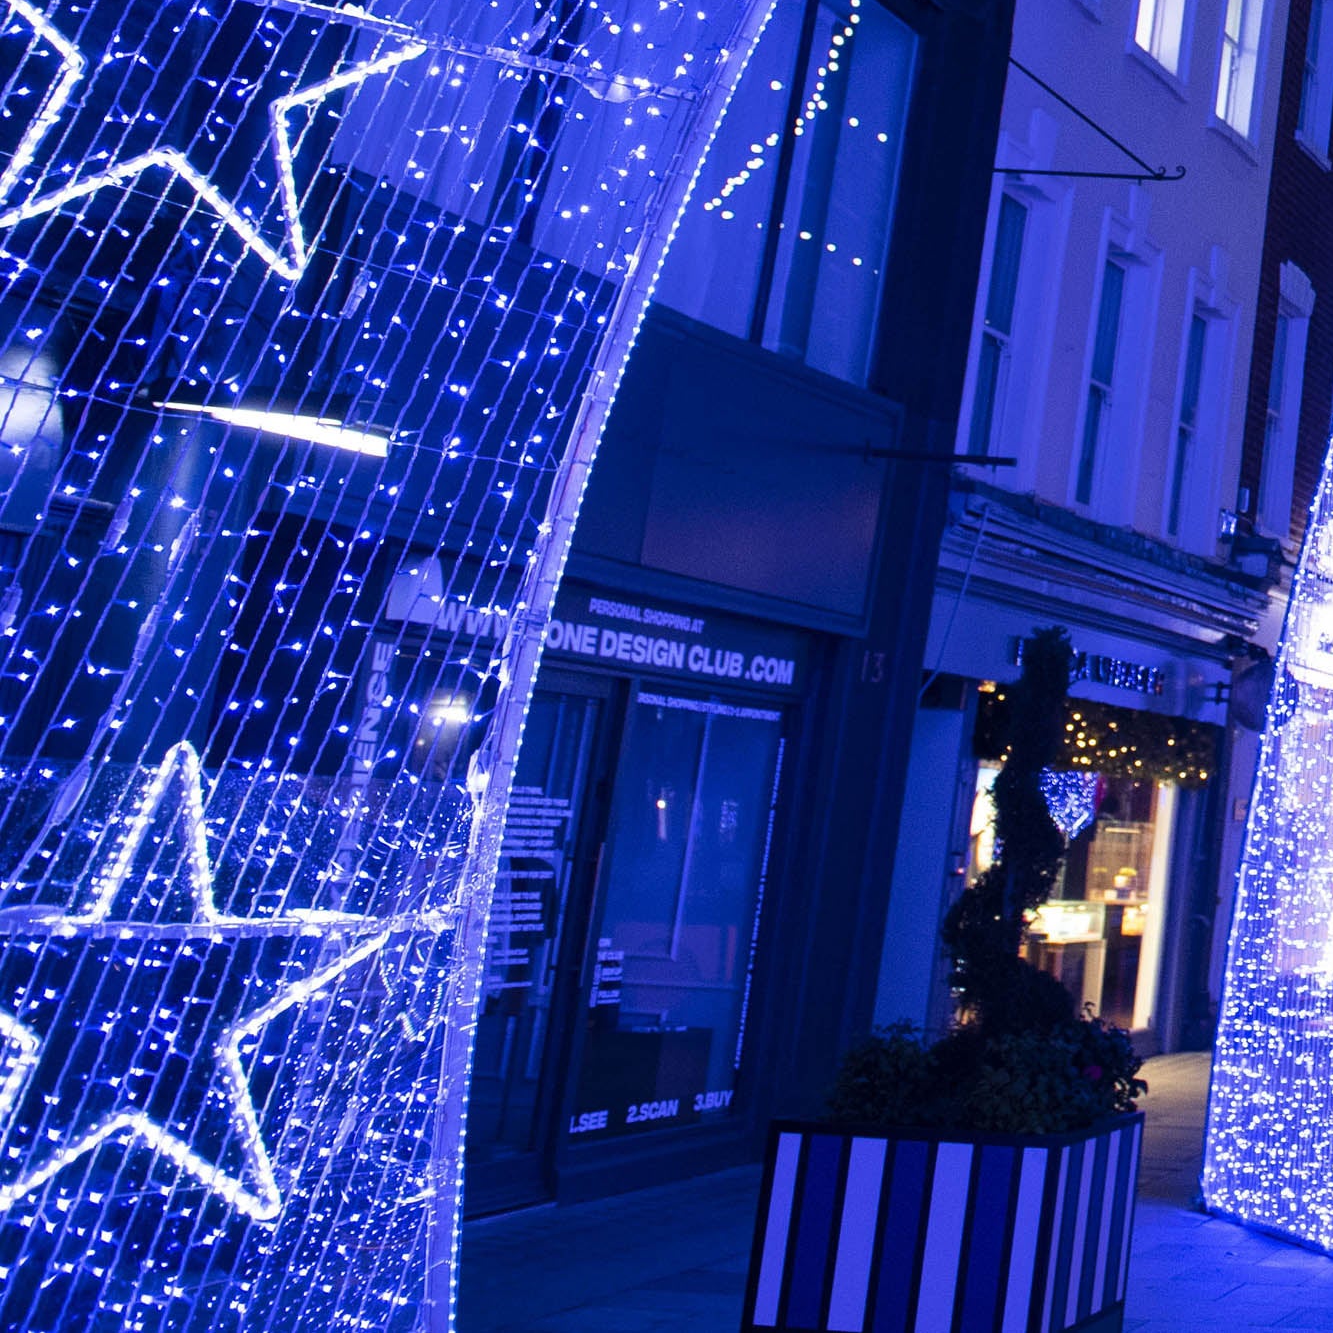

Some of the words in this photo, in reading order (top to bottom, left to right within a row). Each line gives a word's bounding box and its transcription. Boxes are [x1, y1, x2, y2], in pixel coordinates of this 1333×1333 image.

[588, 597, 641, 623] PERSONAL
[642, 608, 691, 632] SHOPPING
[690, 618, 704, 634] AT
[600, 630, 684, 667] DESIGN
[687, 648, 744, 674] CLUB
[745, 654, 795, 685] .COM
[860, 650, 886, 683] 13
[626, 1099, 679, 1124] 2.SCAN
[693, 1090, 734, 1112] 3.BUY
